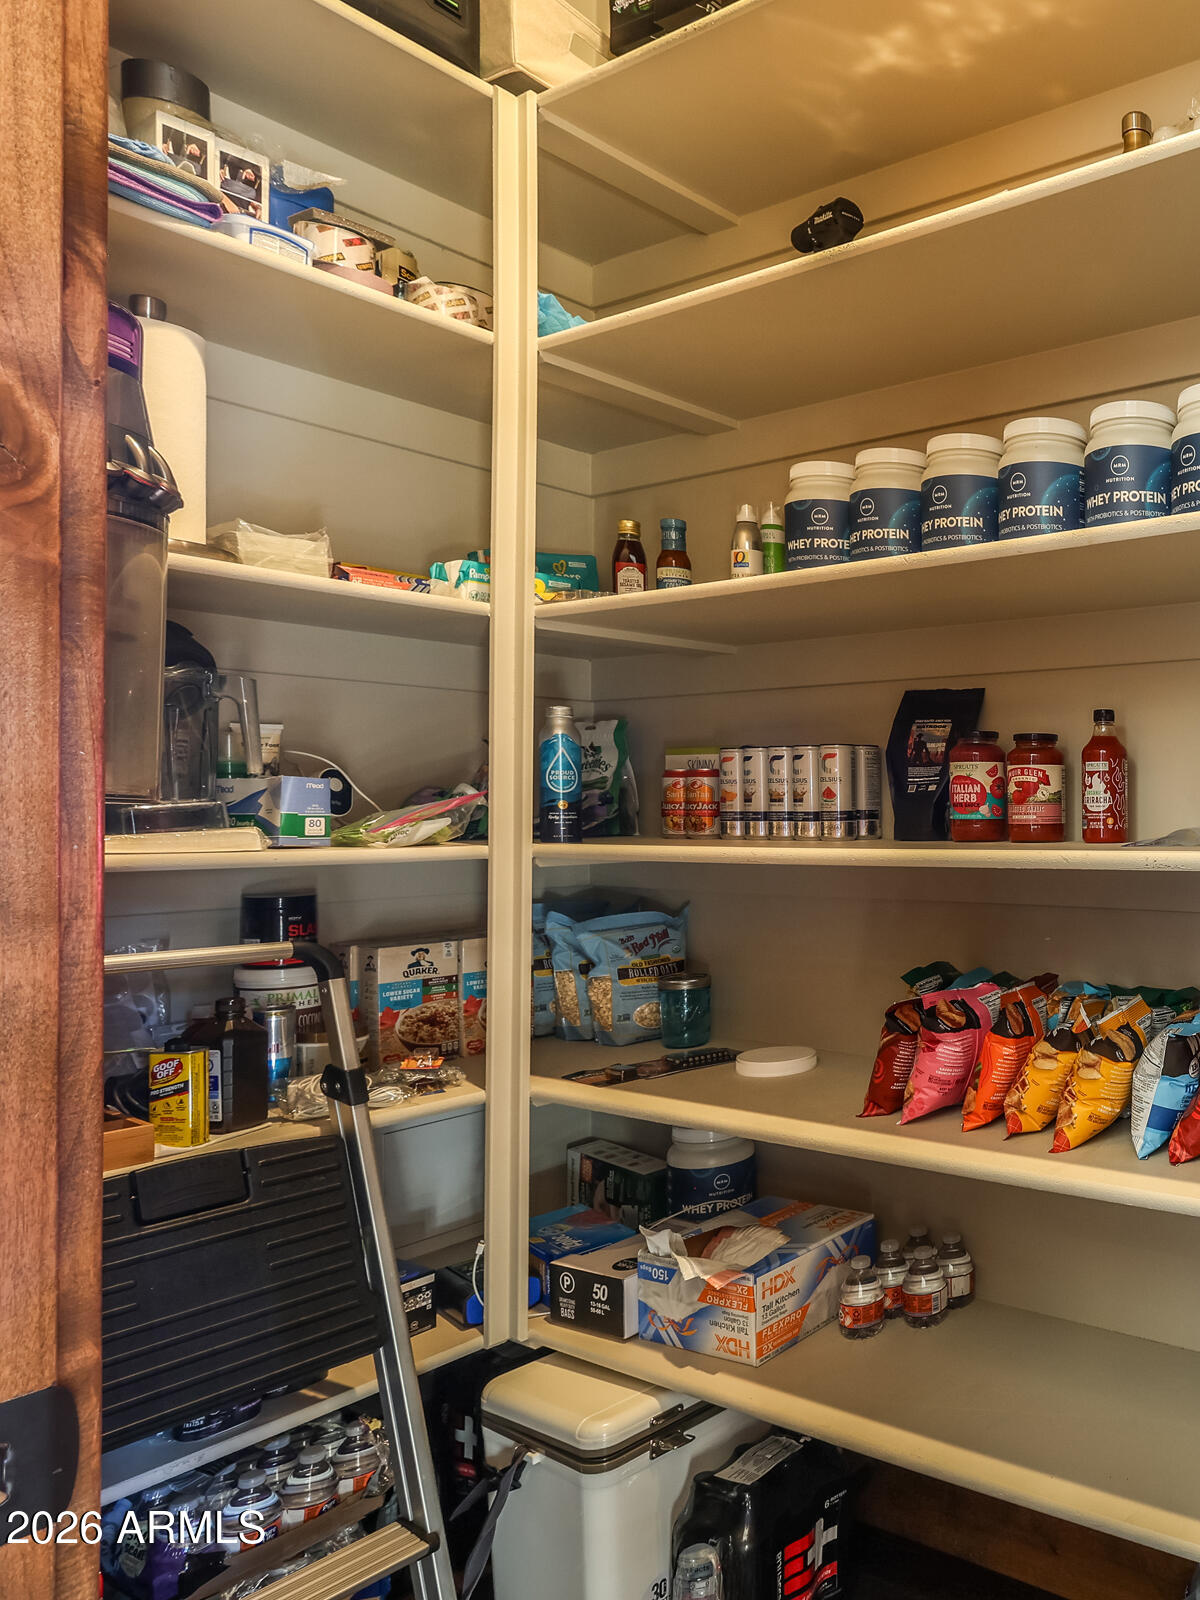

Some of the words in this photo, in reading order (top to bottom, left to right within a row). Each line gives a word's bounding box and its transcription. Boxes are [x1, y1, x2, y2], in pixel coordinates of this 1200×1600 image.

[1177, 465, 1200, 475] NUTRITION
[1086, 492, 1111, 509] WHEY
[1113, 490, 1166, 504] PROTEIN
[1013, 505, 1063, 518] PROTEIN
[1095, 511, 1123, 520] PROBIOTICS
[934, 516, 983, 530] PROTEIN
[1026, 523, 1062, 531] POSTBIOTICS
[862, 528, 910, 541] PROTEIN
[788, 538, 812, 551] WHEY
[814, 538, 850, 550] PROTE
[469, 567, 490, 582] Pamp
[1023, 768, 1043, 777] GLEN
[951, 784, 981, 793] ITALIAN
[953, 793, 977, 803] HERB
[309, 819, 321, 828] 80
[288, 924, 317, 937] SLA
[631, 940, 650, 955] Red
[644, 957, 671, 967] FASHIONED
[402, 967, 439, 978] QUAKER
[628, 966, 659, 978] ROLLED
[660, 962, 679, 975] OATS
[267, 989, 319, 1004] PRIMAL
[153, 1059, 180, 1073] GOOF
[156, 1067, 175, 1079] OFF
[717, 1192, 753, 1211] PROTEIN
[652, 1267, 669, 1281] 150
[762, 1266, 796, 1300] HDX
[592, 1283, 608, 1301] 50
[736, 1286, 748, 1295] 2X
[706, 1295, 748, 1311] FLEXPRO
[762, 1302, 773, 1313] Tall
[775, 1289, 800, 1306] Kitchen
[560, 1307, 575, 1319] BAGS
[769, 1304, 786, 1316] Gallon
[709, 1320, 734, 1332] Kitchen
[723, 1317, 743, 1326] Gallon
[763, 1310, 802, 1339] FLEXPRO
[734, 1325, 749, 1335] Tall
[715, 1334, 750, 1359] HDX
[762, 1341, 774, 1354] 2X
[651, 1577, 668, 1598] 30
